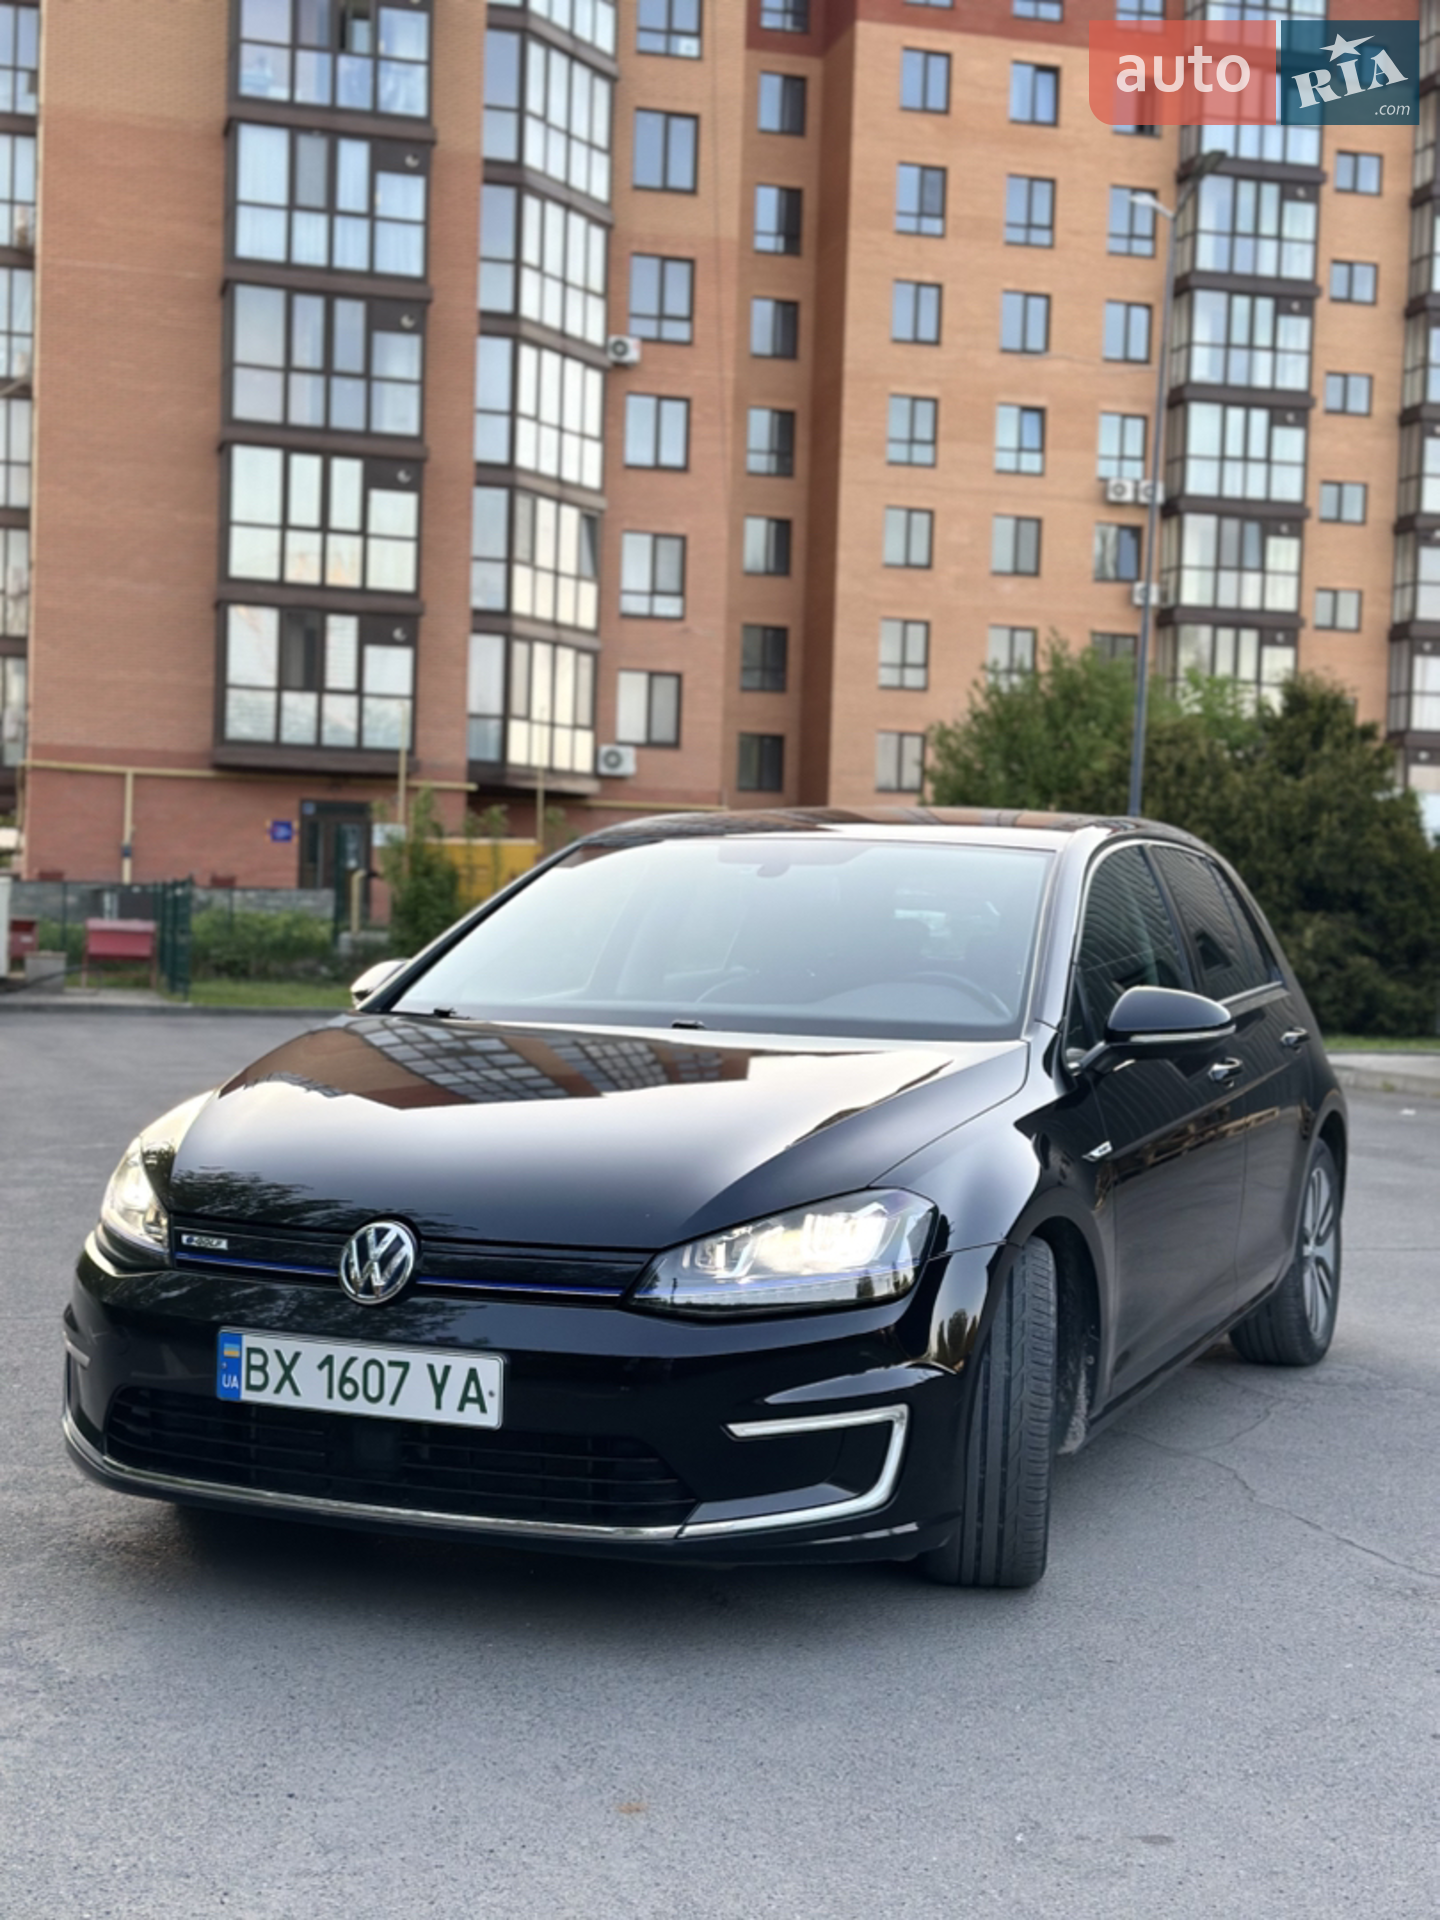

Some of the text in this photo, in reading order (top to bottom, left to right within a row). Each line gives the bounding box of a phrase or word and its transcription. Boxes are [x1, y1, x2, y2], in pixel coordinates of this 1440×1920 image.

[222, 1374, 240, 1389] UA
[245, 1347, 488, 1414] BX 1607 YA
